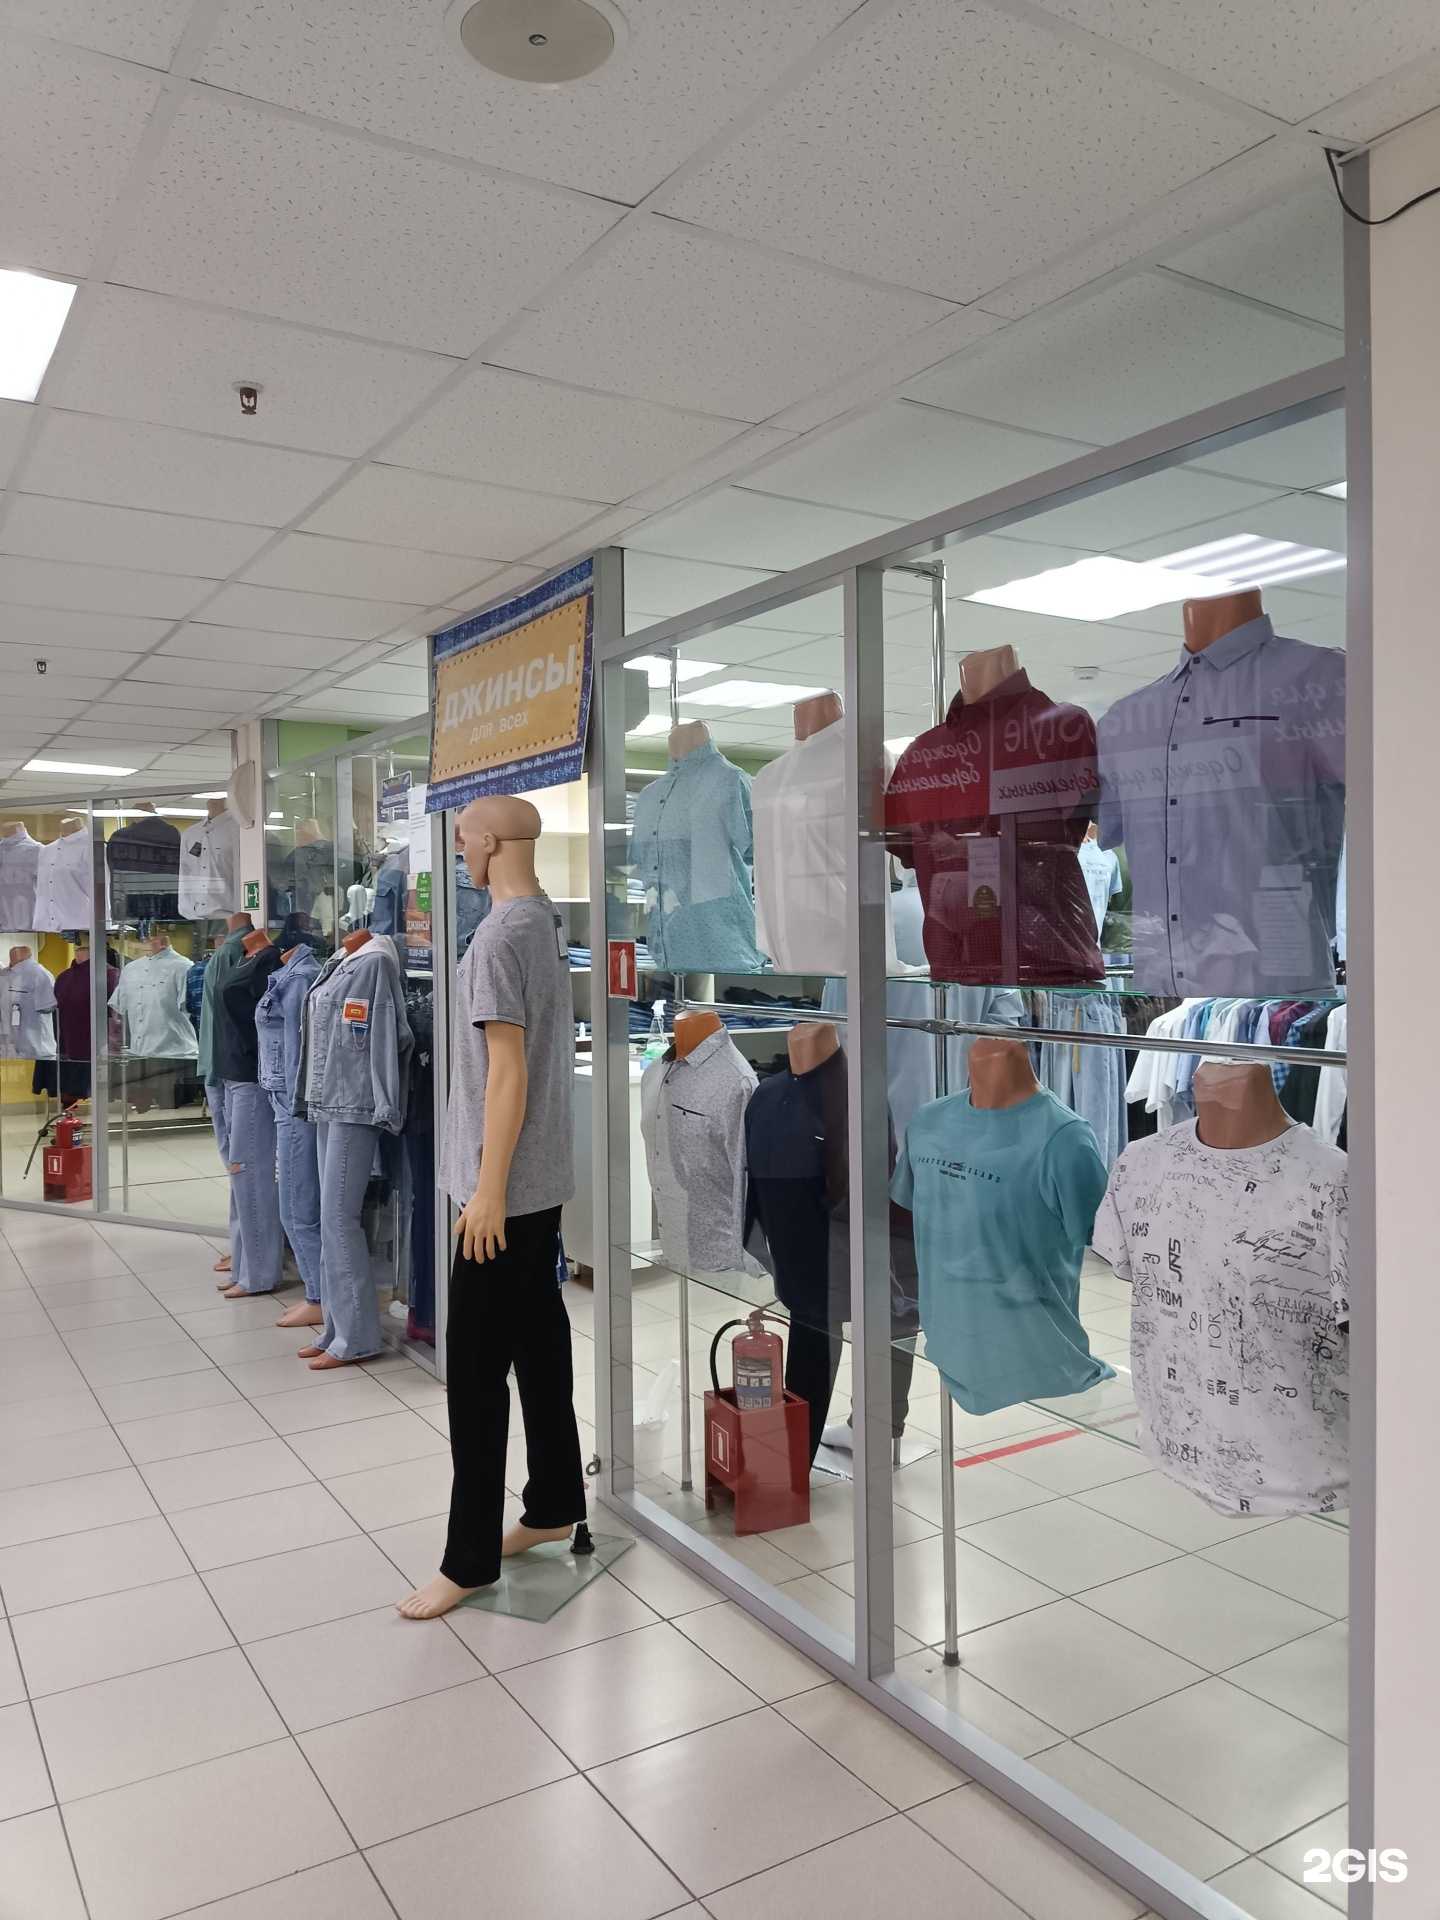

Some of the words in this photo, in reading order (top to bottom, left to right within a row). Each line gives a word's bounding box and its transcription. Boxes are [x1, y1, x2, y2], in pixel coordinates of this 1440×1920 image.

[441, 644, 577, 733] ДЖИНСЫ
[469, 723, 493, 746] для
[499, 710, 529, 733] всех
